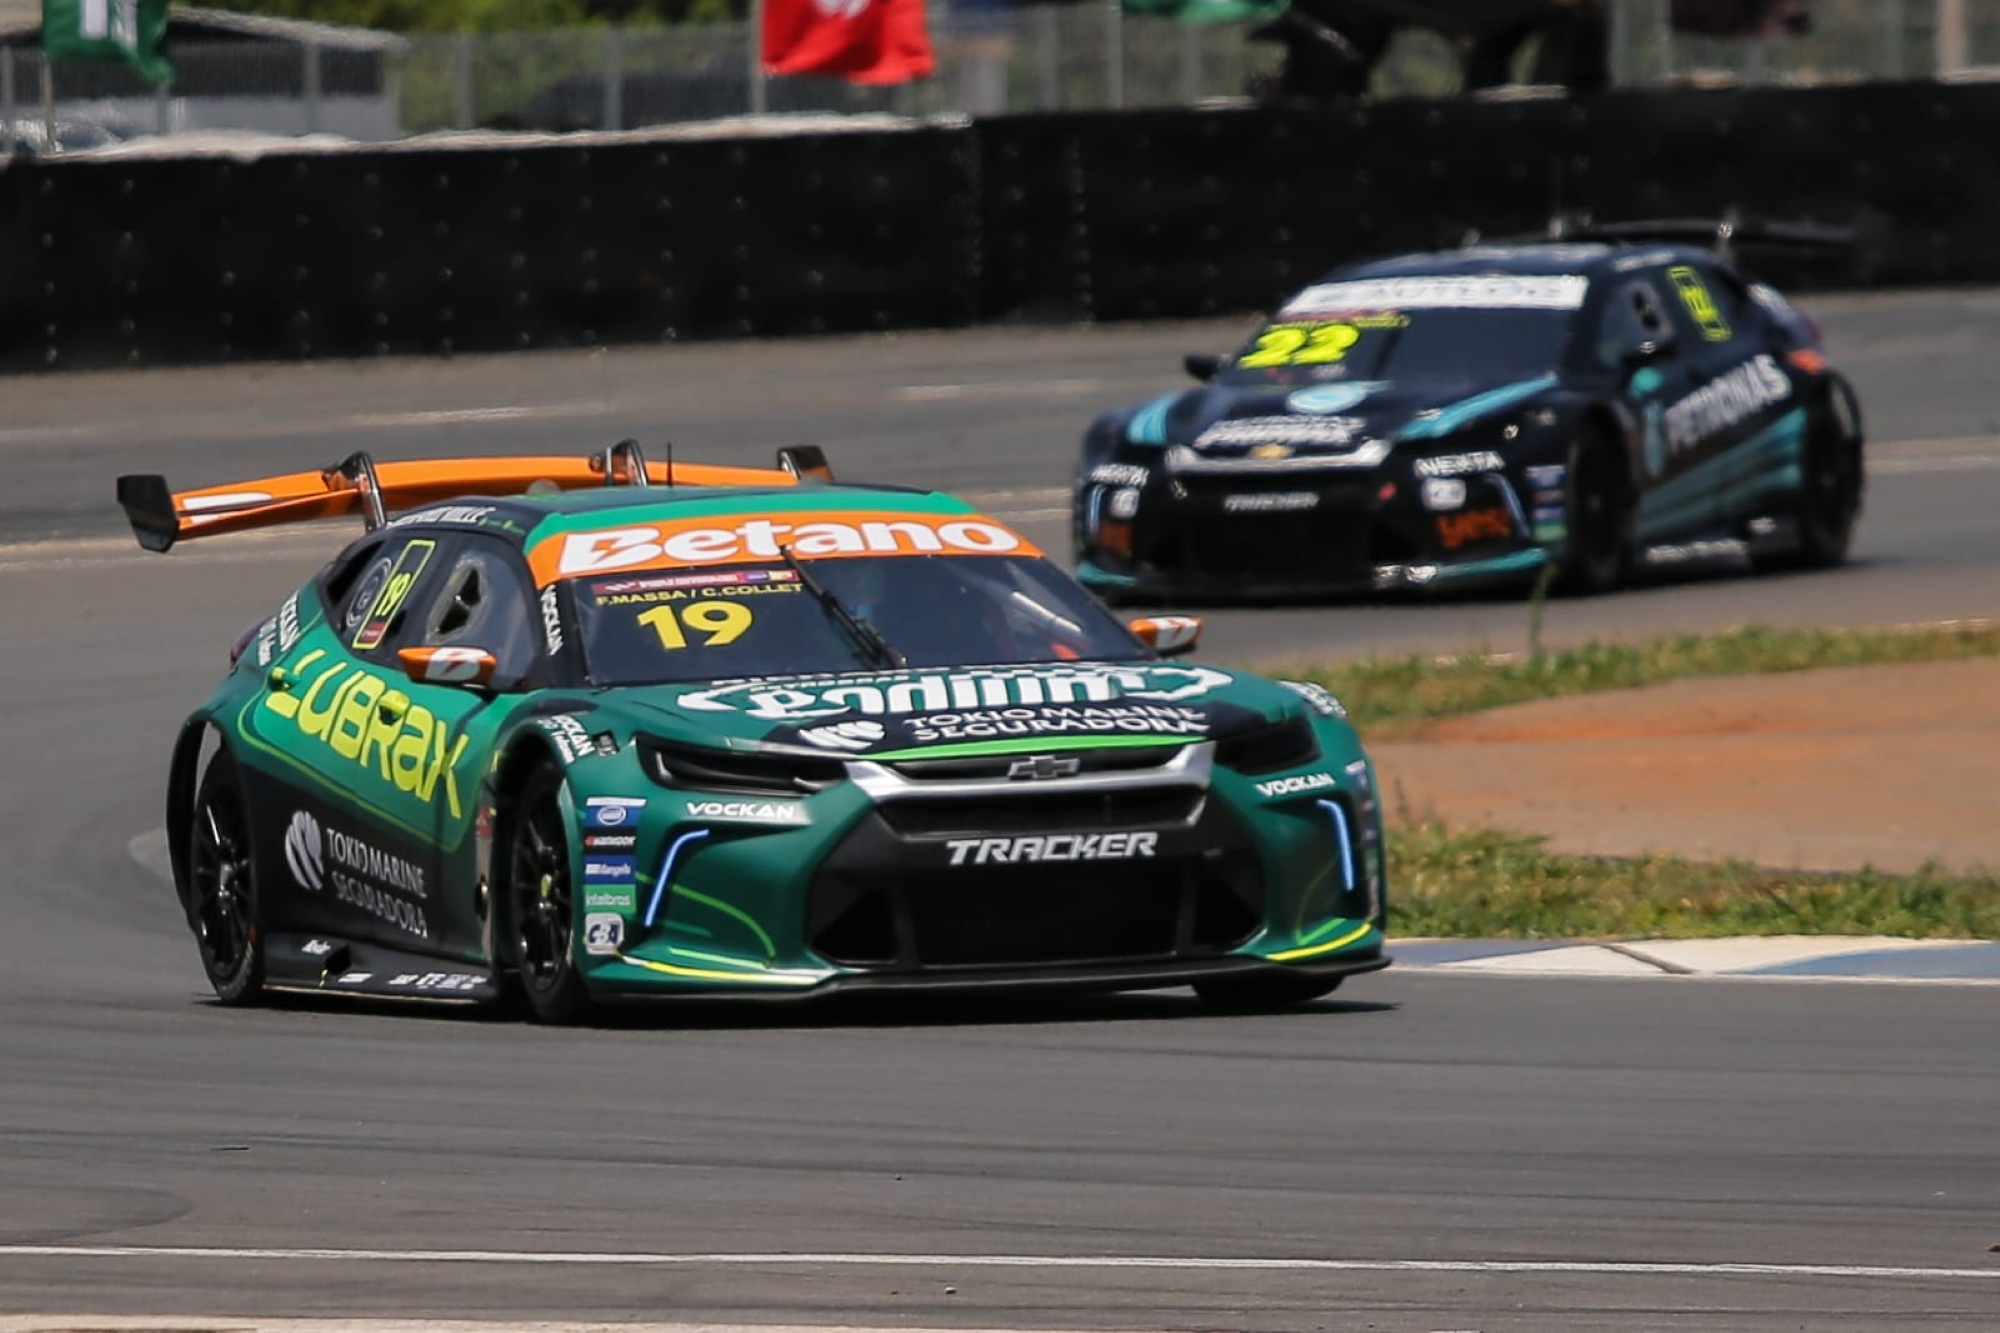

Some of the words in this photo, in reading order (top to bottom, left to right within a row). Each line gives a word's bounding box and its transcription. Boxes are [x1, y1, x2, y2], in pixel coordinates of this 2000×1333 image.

[1238, 323, 1361, 369] 22
[558, 518, 1020, 574] Betano
[596, 587, 687, 606] F.MASSA
[701, 582, 805, 598] C.COLLET
[636, 600, 753, 649] 19
[902, 708, 1037, 728] TOKIO
[1041, 706, 1207, 721] MARINE
[913, 718, 1212, 740] SEGURADORA
[1255, 772, 1336, 797] VOCKAN
[686, 802, 796, 817] VOCKAN
[945, 831, 1159, 865] TRACKER
[326, 828, 369, 874] TOKIO
[369, 847, 428, 898] MARINE
